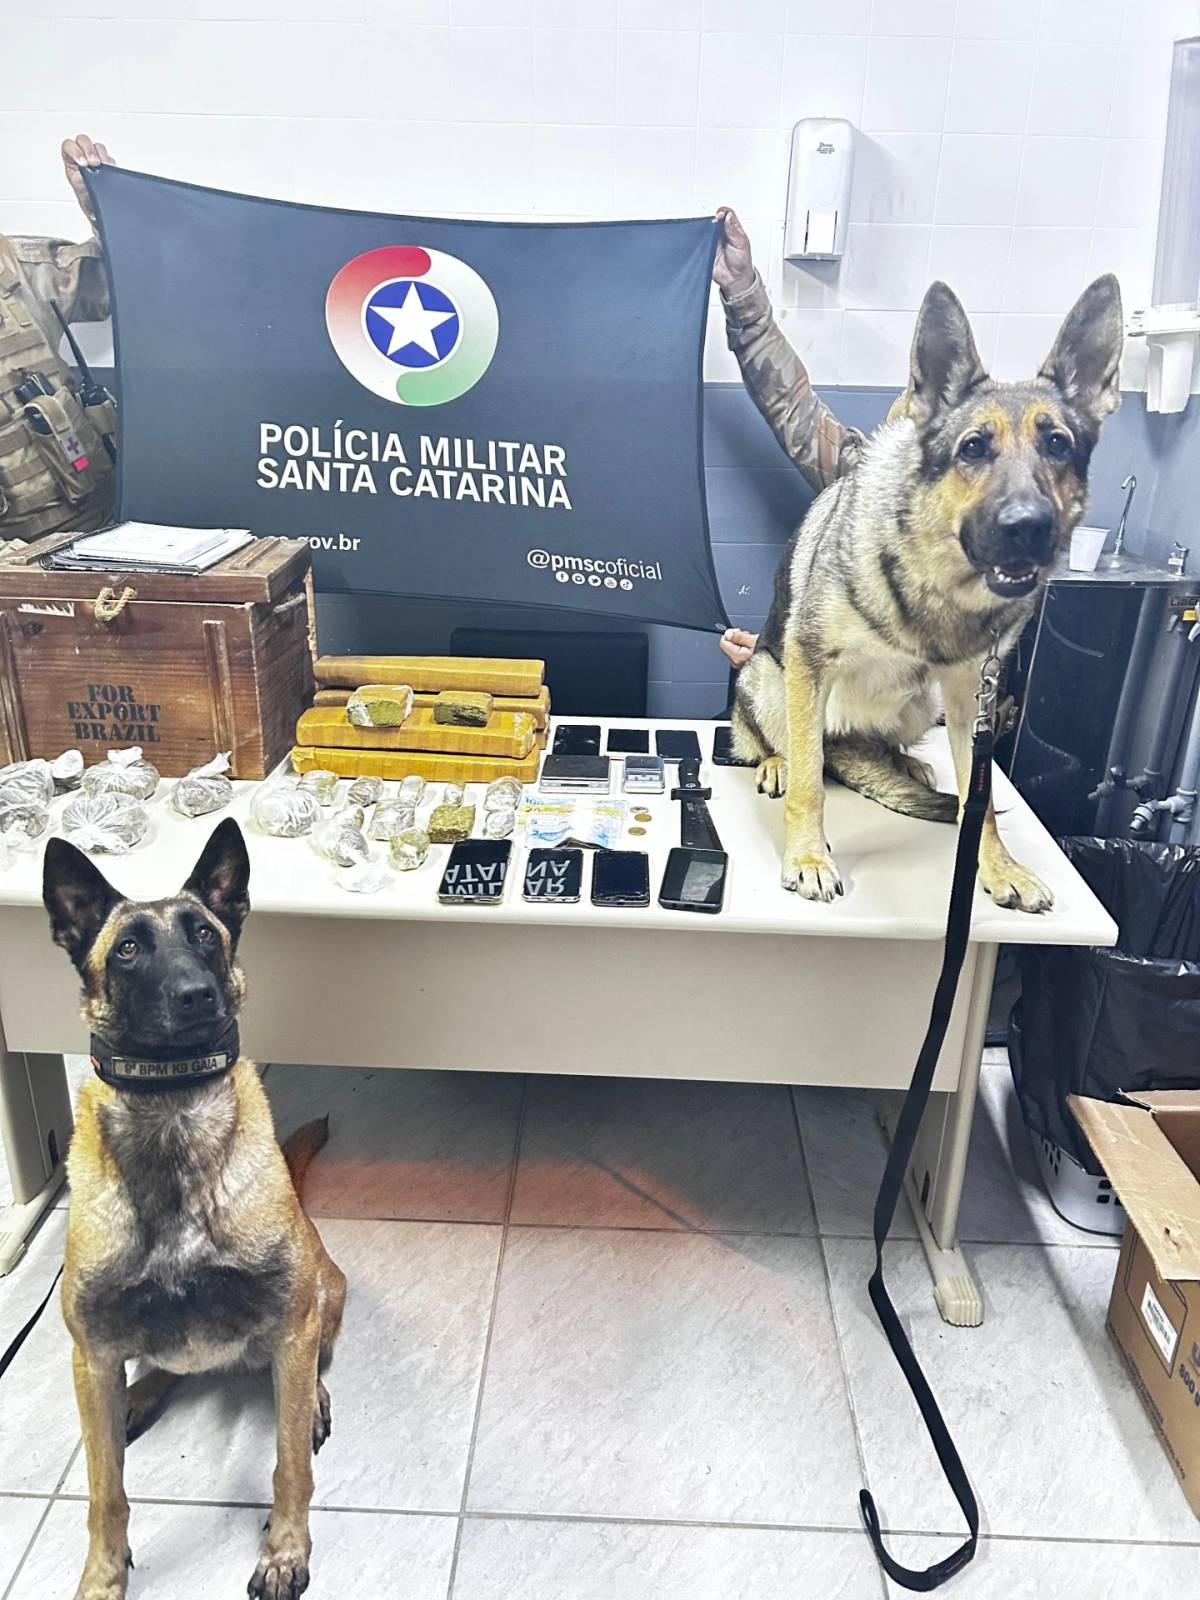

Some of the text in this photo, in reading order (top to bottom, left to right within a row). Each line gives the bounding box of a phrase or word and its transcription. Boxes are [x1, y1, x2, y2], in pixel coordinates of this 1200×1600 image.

[260, 419, 568, 477] POLÍCIA MILITAR
[256, 457, 573, 510] SANTA CATARINA
[527, 549, 662, 580] @pmscoficial
[88, 684, 136, 702] FOR
[67, 702, 160, 721] EXPORT
[74, 722, 161, 741] BRAZIL
[139, 1063, 168, 1076] BPM
[172, 1062, 188, 1074] K9
[191, 1057, 218, 1073] GAIA
